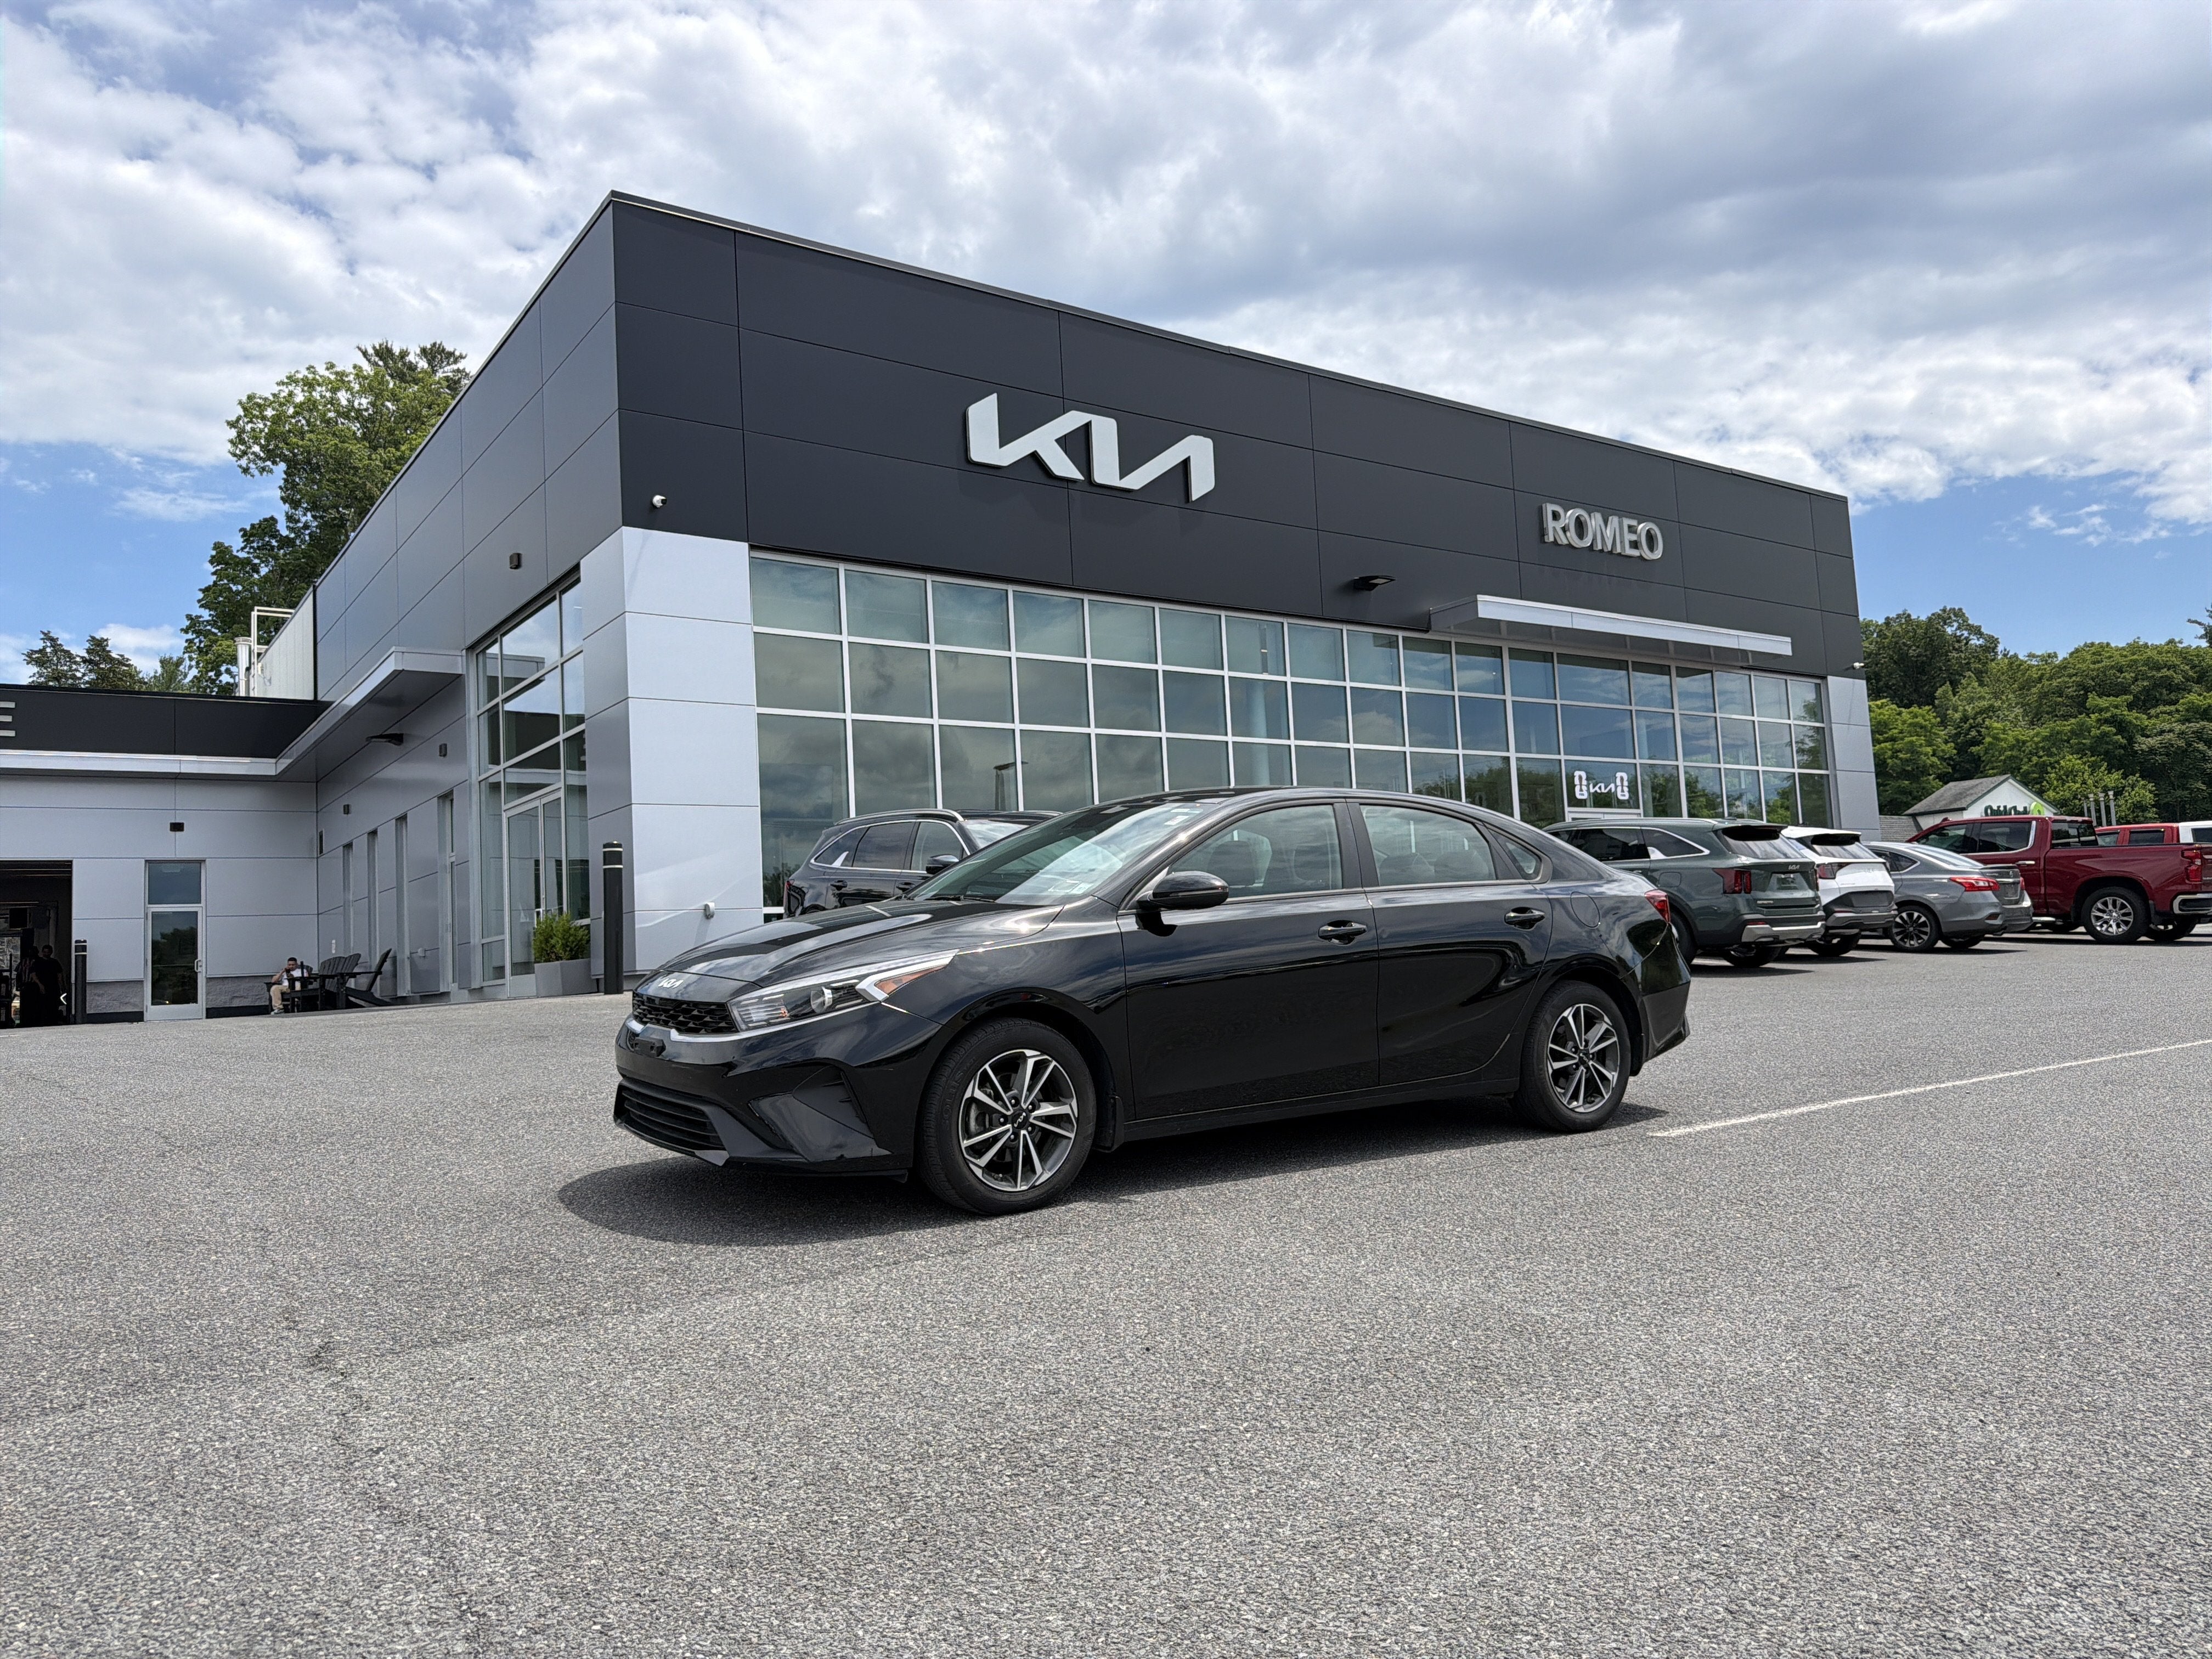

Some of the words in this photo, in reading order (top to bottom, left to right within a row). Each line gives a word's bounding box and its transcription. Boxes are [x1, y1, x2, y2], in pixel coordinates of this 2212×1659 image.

[966, 393, 1215, 501] KIA
[1542, 503, 1663, 560] ROMEO
[1589, 783, 1615, 793] KIA
[658, 978, 684, 988] KIA
